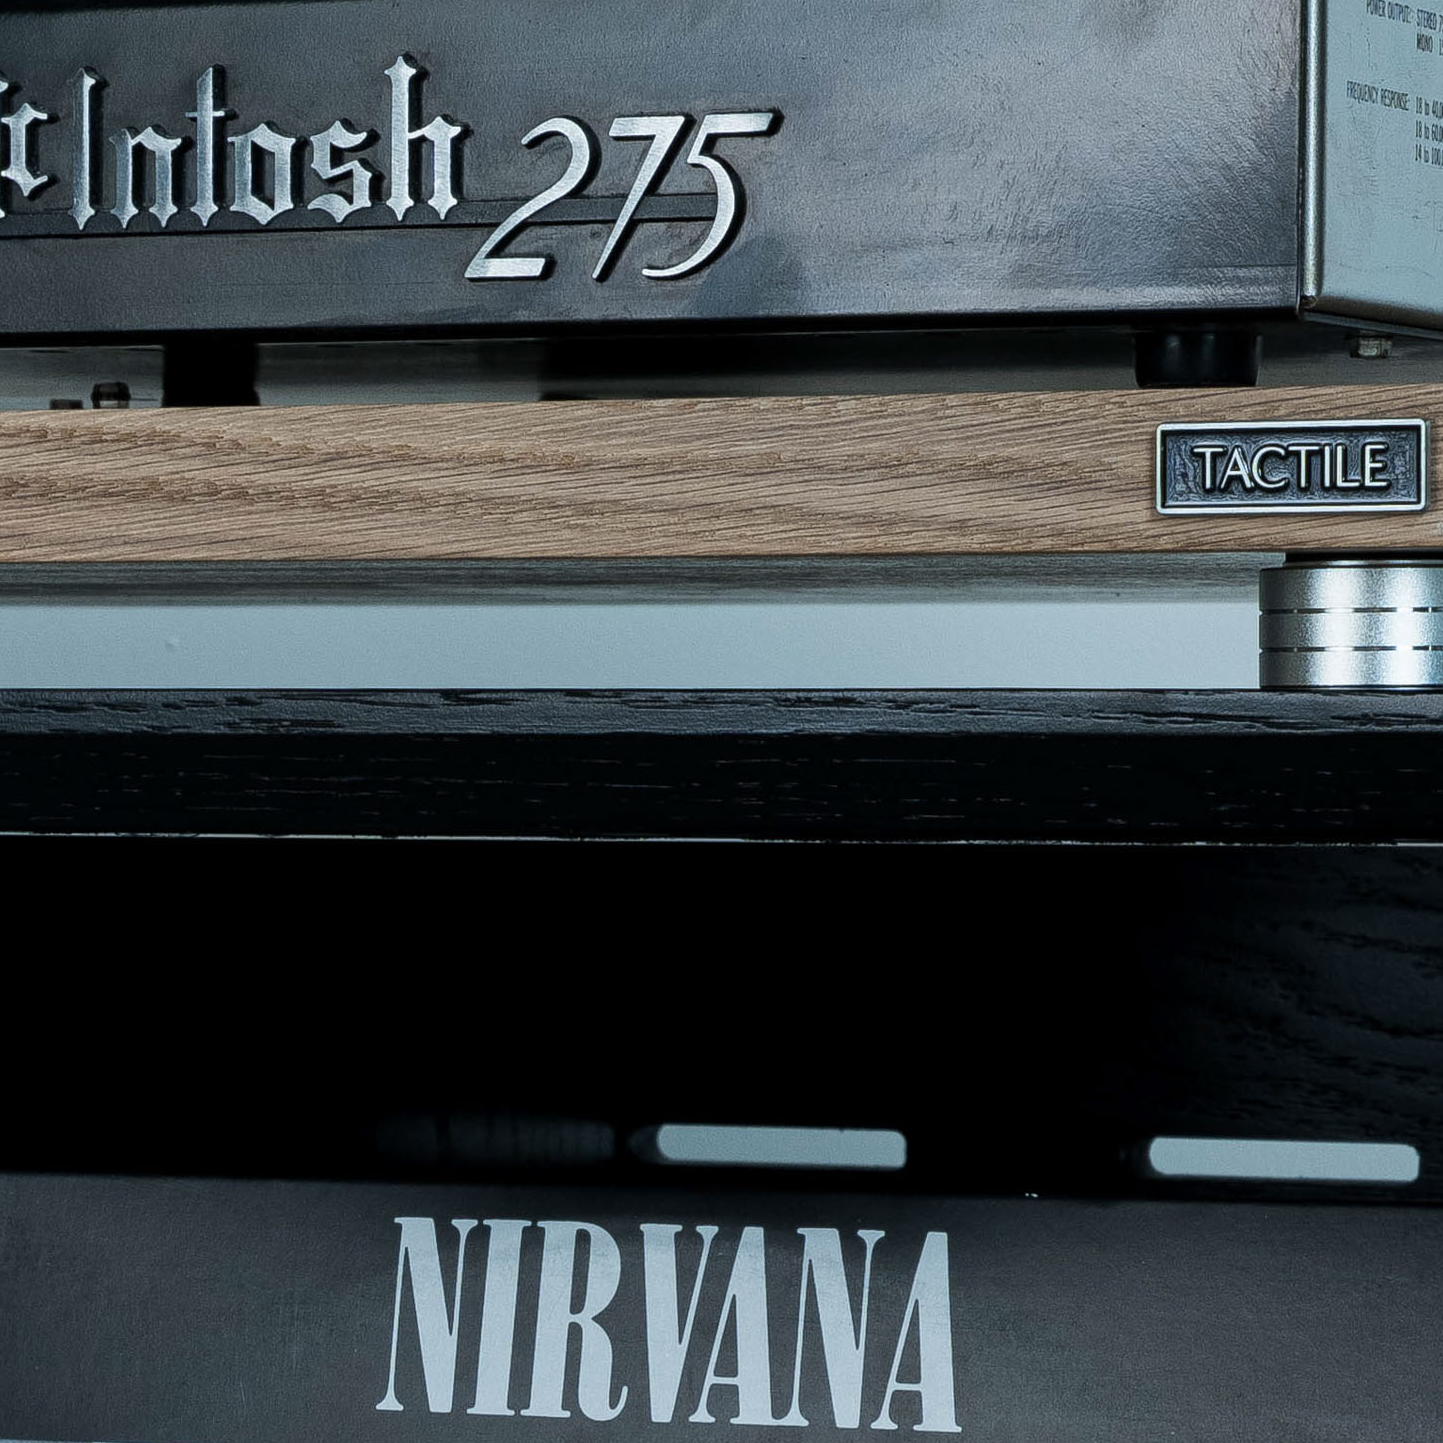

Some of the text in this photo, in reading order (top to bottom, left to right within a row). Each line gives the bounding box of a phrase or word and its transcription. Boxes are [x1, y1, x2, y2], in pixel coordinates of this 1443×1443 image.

[1416, 9, 1437, 30] STEREO
[1346, 80, 1379, 104] FREQUENCY
[1415, 96, 1422, 114] 18
[1424, 99, 1430, 116] to
[1415, 120, 1422, 138] 18
[1424, 123, 1430, 140] to
[1415, 144, 1422, 161] 14
[1423, 146, 1429, 163] to
[465, 107, 782, 284] 275
[1192, 442, 1390, 490] TACTILE
[375, 1216, 963, 1433] NIRVANA
